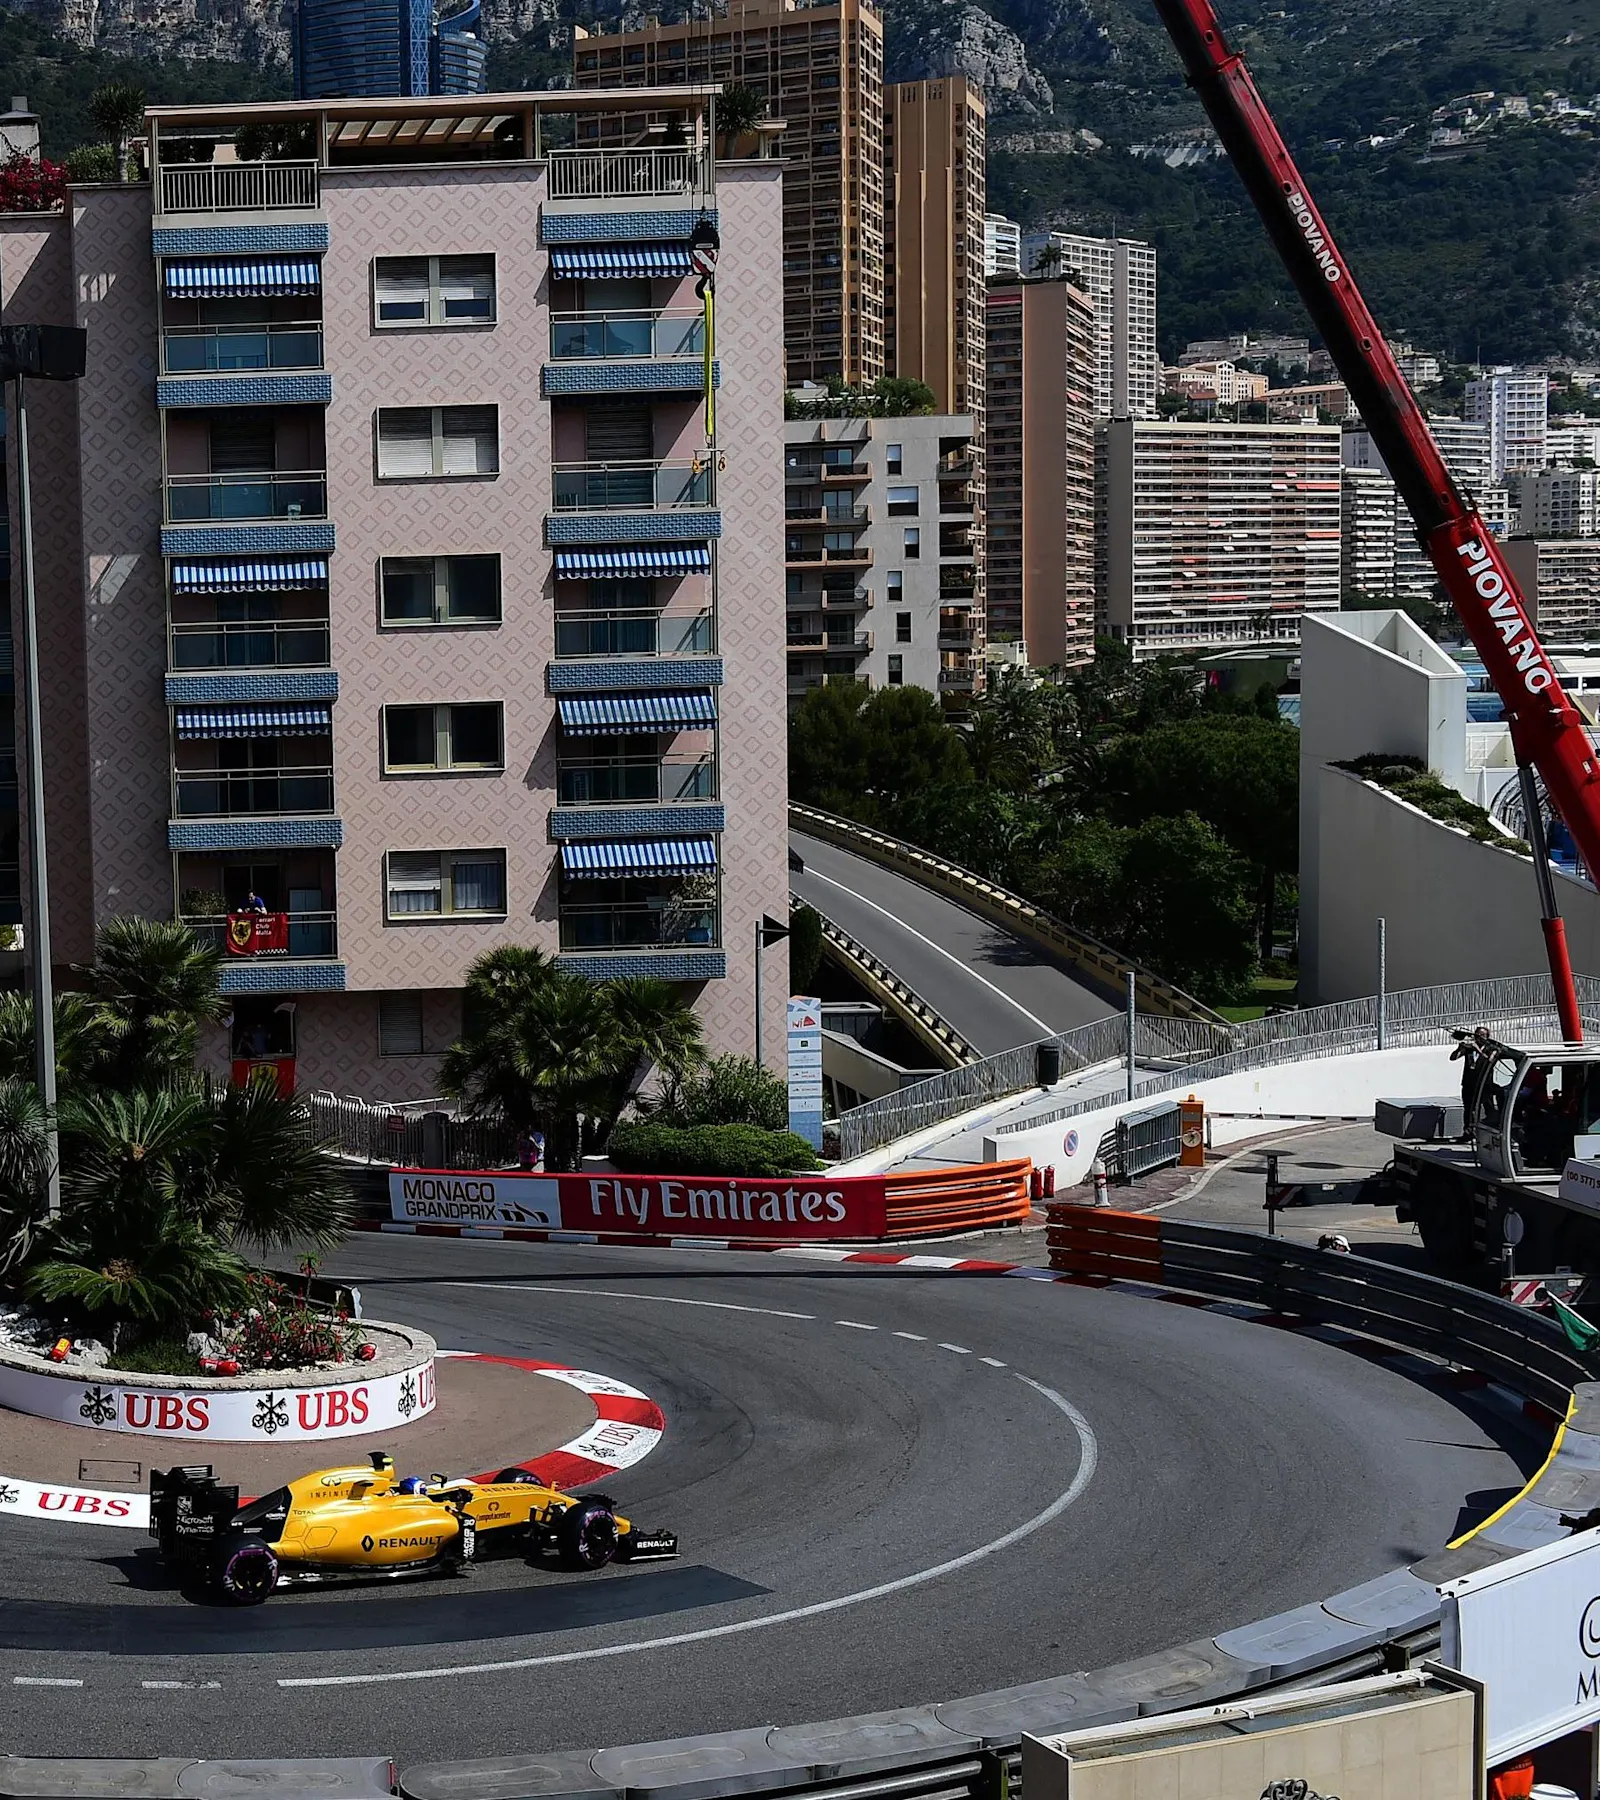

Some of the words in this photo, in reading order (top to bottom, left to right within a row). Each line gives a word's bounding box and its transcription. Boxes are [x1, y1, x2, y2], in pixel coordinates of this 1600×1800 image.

[1287, 192, 1340, 281] PIOVANO
[1457, 539, 1551, 695] PIOVANO
[403, 1179, 496, 1203] MONACO
[589, 1179, 650, 1225] Fly
[661, 1181, 847, 1223] Emirates
[405, 1200, 497, 1220] GRANDPRIX
[123, 1393, 210, 1431] UBS
[296, 1387, 369, 1430] UBS
[594, 1423, 641, 1447] UBS
[38, 1491, 131, 1517] UBS
[176, 1514, 214, 1524] Microsoft
[176, 1525, 214, 1535] Dynamics
[379, 1536, 444, 1548] RENAULT
[636, 1539, 675, 1549] RENAULT
